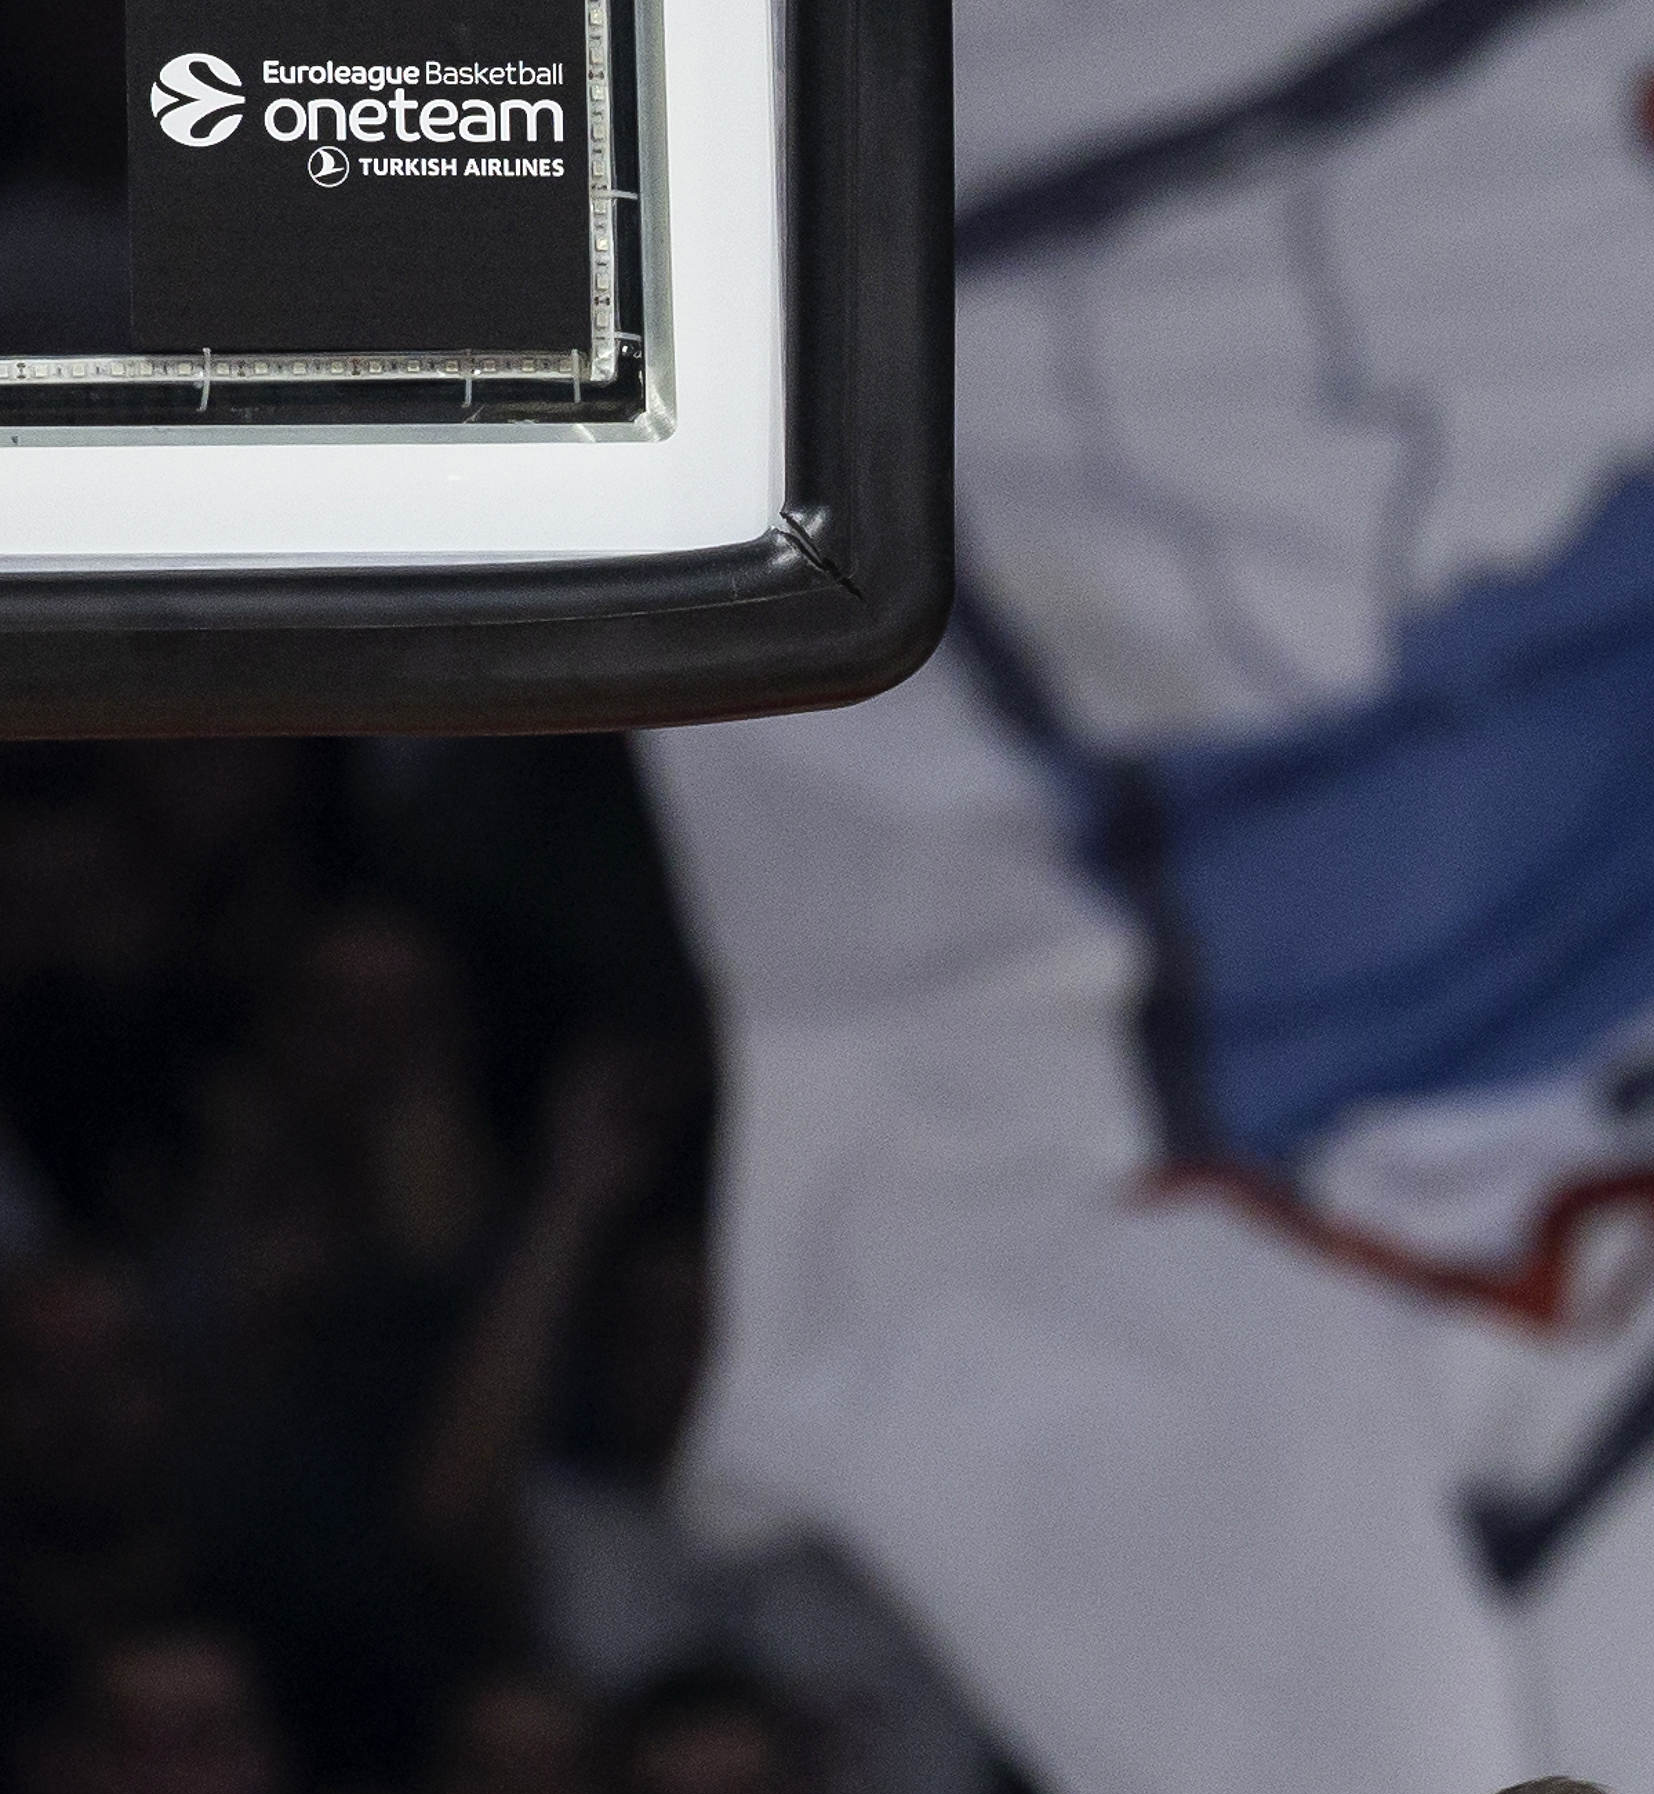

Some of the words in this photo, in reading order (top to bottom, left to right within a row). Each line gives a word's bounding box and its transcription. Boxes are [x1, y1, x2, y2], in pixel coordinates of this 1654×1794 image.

[263, 60, 420, 91] Euroleague
[425, 60, 563, 85] Basketball
[264, 88, 563, 142] oneteam
[359, 158, 457, 177] TURKISH
[463, 158, 564, 177] AIRLINES
